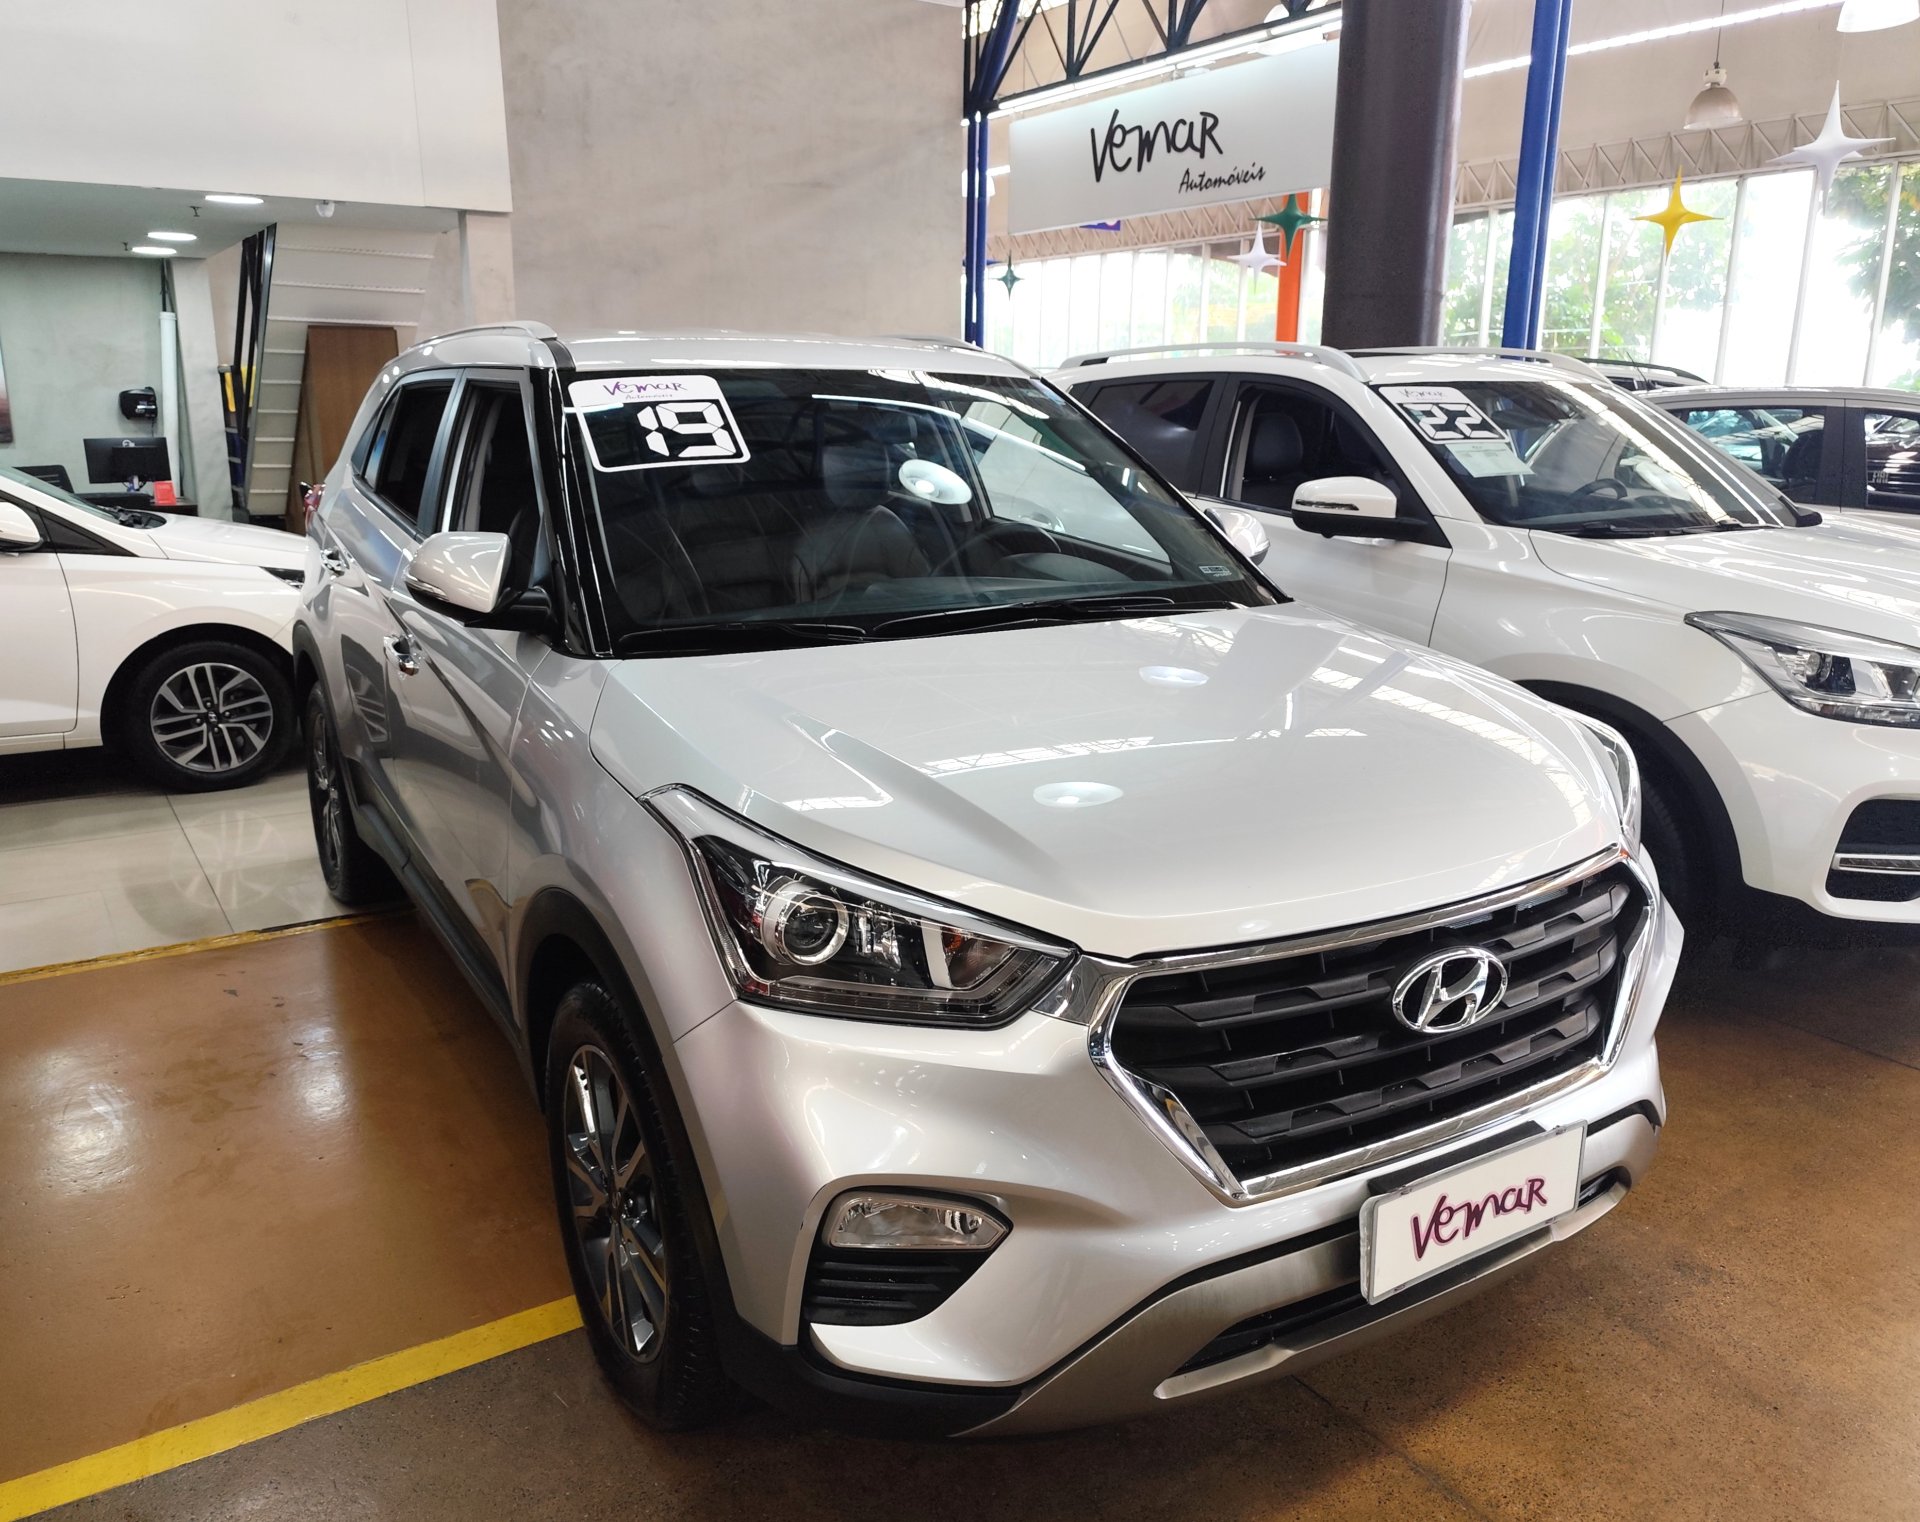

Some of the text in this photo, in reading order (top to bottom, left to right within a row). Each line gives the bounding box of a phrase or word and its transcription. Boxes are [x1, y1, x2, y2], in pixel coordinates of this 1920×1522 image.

[1178, 161, 1266, 194] Automóveis
[637, 402, 737, 457] 19
[1402, 403, 1500, 439] 22
